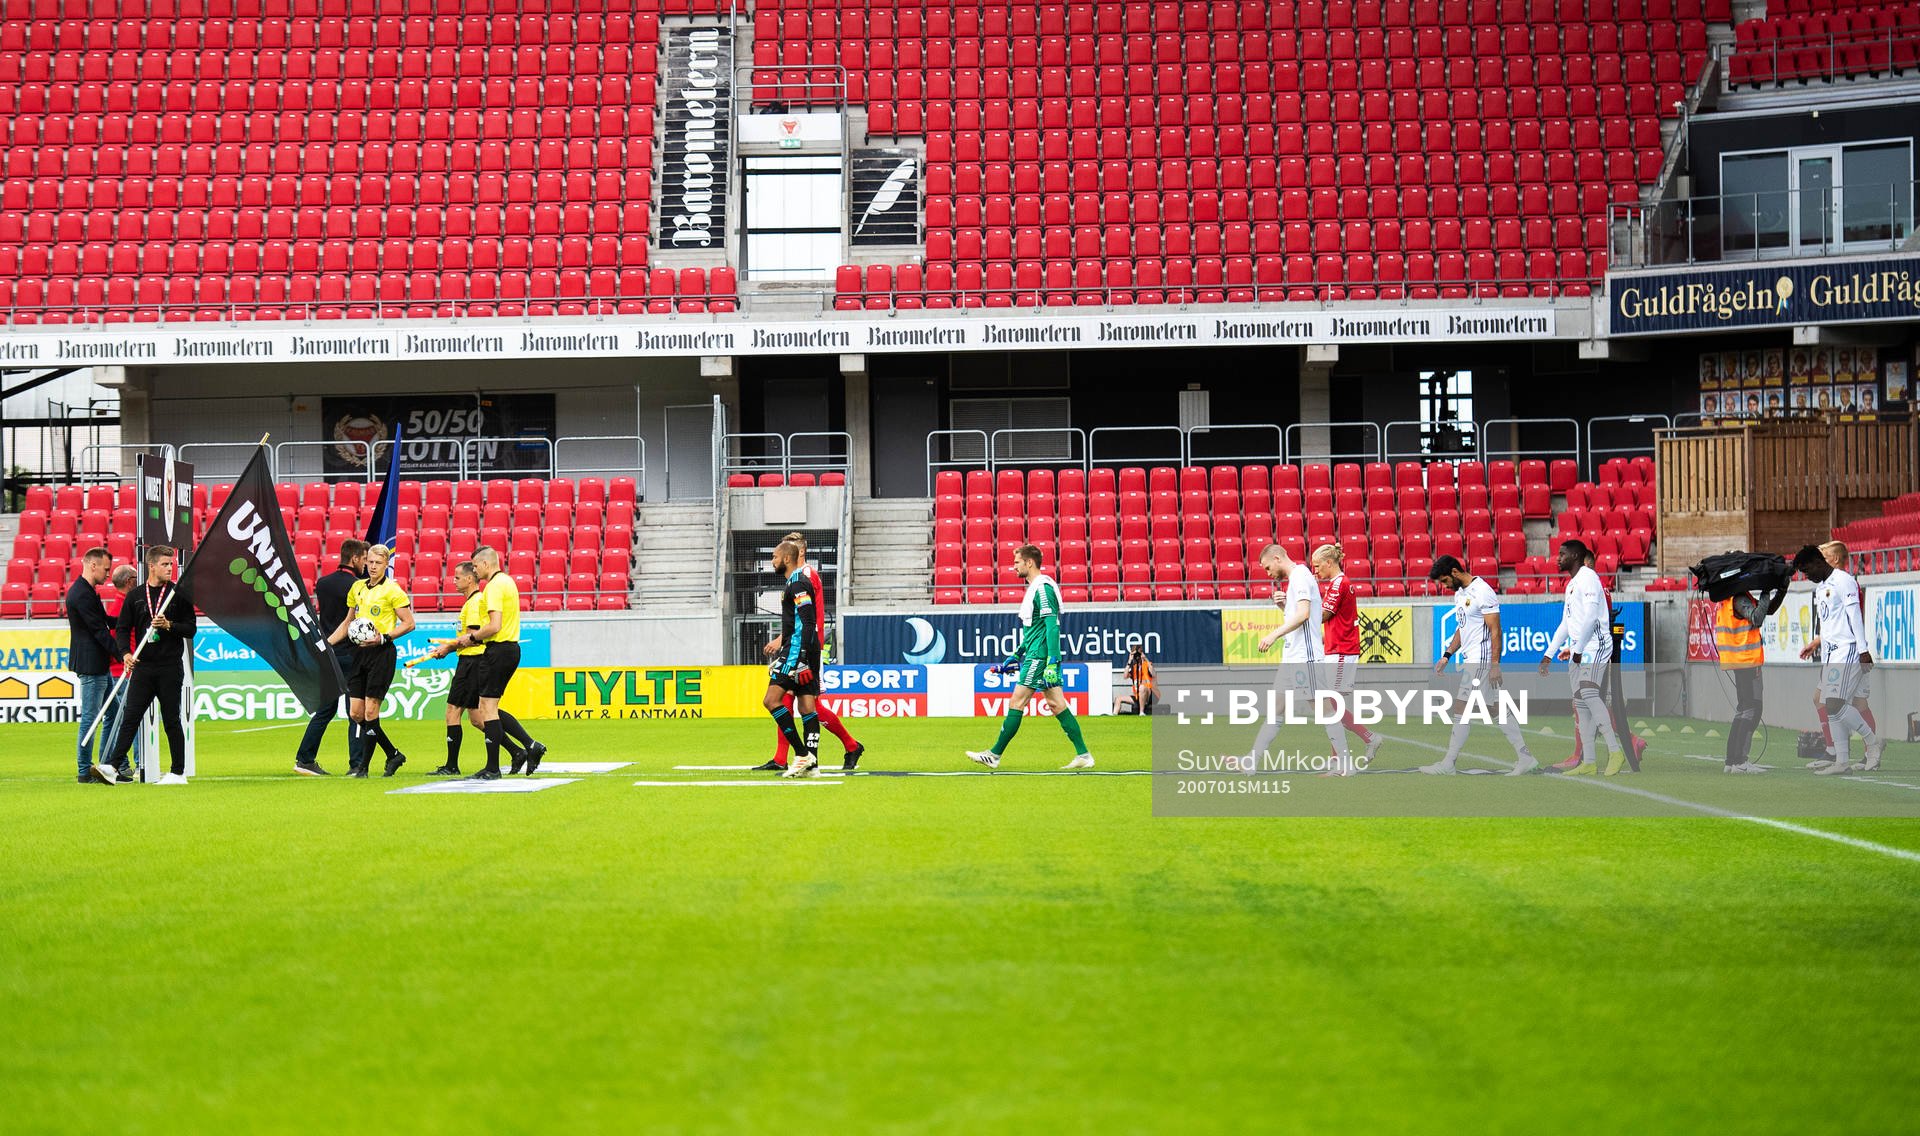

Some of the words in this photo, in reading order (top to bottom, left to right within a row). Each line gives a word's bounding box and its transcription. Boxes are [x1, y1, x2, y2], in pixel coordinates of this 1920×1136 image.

[671, 27, 720, 247] Barometern
[1620, 281, 1773, 320] GuldFågeln
[57, 340, 156, 359] Barometern
[174, 338, 273, 357] Barometern
[290, 336, 389, 355] Barometern
[403, 334, 503, 353] Barometern
[519, 332, 618, 351] Barometern
[634, 331, 734, 350] Barometern
[750, 329, 850, 348] Barometern
[866, 326, 965, 346] Barometern
[982, 324, 1081, 343] Barometern
[1097, 322, 1197, 341] Barometern
[1213, 319, 1313, 339] Barometern
[1329, 317, 1430, 337] Barometern
[1446, 315, 1547, 335] Barometern
[407, 409, 484, 435] 50/50
[1247, 622, 1282, 632] Superm
[1883, 590, 1916, 660] STENA
[554, 670, 702, 706] HYLTE
[823, 669, 919, 689] SPORT
[983, 668, 1080, 688] SPT
[820, 698, 917, 718] VISION
